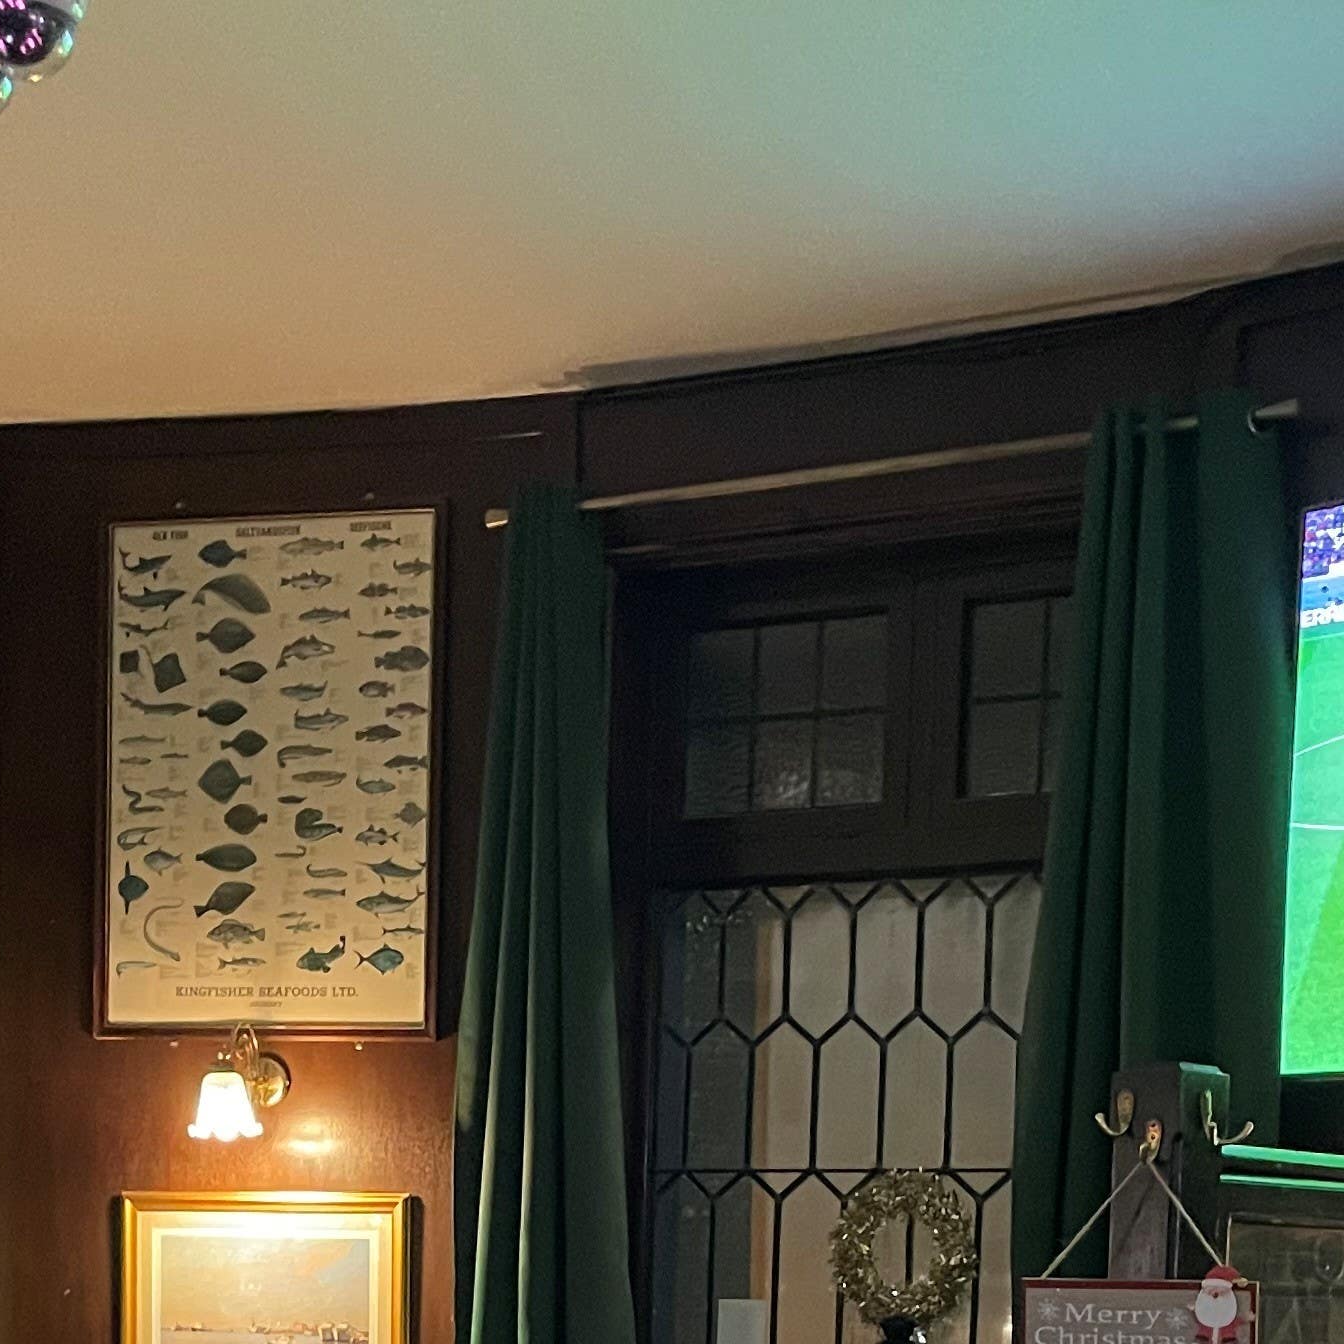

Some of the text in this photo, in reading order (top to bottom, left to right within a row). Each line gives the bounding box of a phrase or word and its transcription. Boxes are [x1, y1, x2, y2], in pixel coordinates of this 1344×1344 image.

[176, 986, 254, 997] KINGFISHER
[258, 986, 328, 997] SEAFOODS
[1064, 1302, 1162, 1329] Merry
